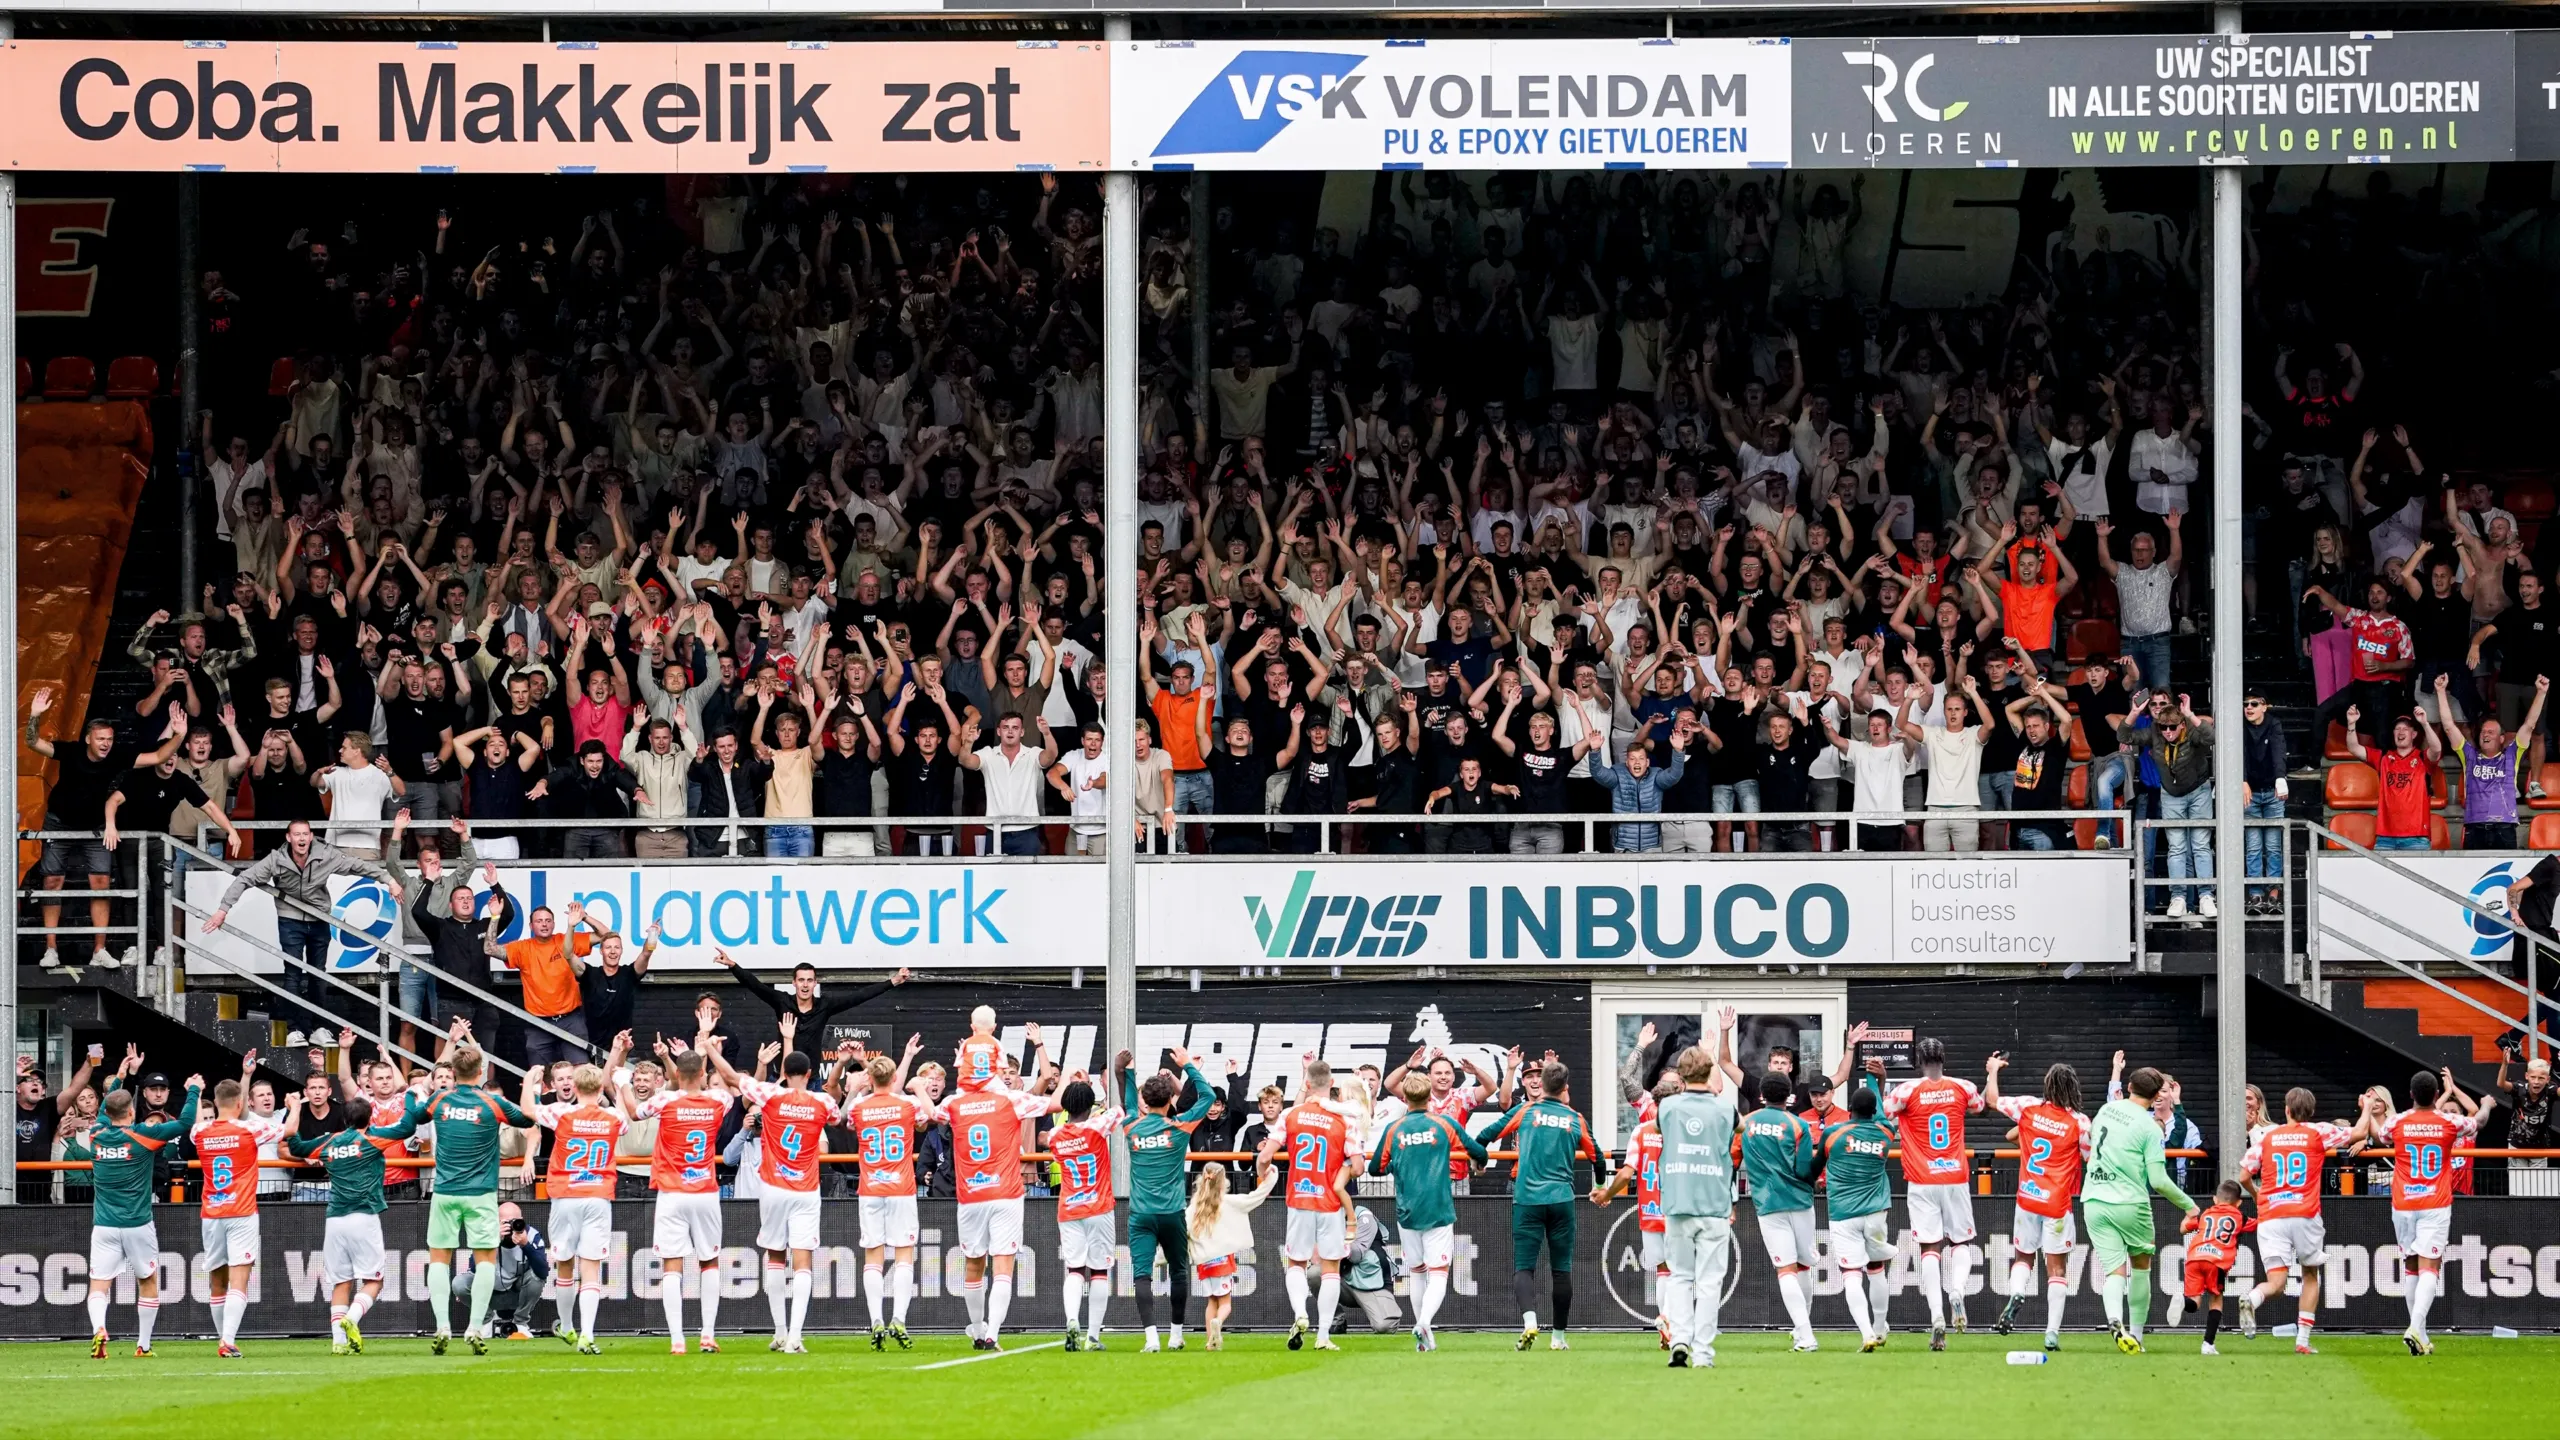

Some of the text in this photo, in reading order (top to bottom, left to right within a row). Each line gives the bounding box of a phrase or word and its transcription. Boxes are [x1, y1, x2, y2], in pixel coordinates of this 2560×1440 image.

[2155, 45, 2373, 79] UW SPECIALIST
[59, 57, 1021, 165] Coba. Makkelijk zat
[1228, 73, 1748, 120] VSK VOLENDAM
[2048, 80, 2481, 118] IN ALLE SOORTEN GIETVLOEREN
[1384, 127, 1748, 155] PU & EPOXY GIETVLOEREN
[1811, 131, 2002, 155] VLOEREN
[2072, 121, 2458, 154] www.rcvloeren.nl
[2357, 638, 2388, 656] HSB
[1911, 866, 2018, 889] industrial
[573, 870, 1009, 960] plaatwerk
[1469, 884, 1850, 959] INBUCO
[1911, 897, 2016, 922] business
[1911, 930, 2055, 959] consultancy
[972, 1051, 990, 1078] 9
[444, 1106, 478, 1122] HSB
[1536, 1112, 1571, 1129] HSB
[1750, 1123, 1783, 1136] HSB
[685, 1129, 706, 1163] 3
[780, 1124, 802, 1161] 4
[861, 1125, 905, 1164] 36
[968, 1124, 990, 1161] 9
[1134, 1134, 1169, 1149] HSB
[1400, 1131, 1435, 1146] HSB
[1849, 1139, 1884, 1155] HSB
[1928, 1113, 1950, 1150] 8
[97, 1147, 129, 1160] HSB
[328, 1145, 360, 1160] HSB
[565, 1137, 609, 1170] 20
[1296, 1132, 1328, 1173] 21
[1677, 1143, 1711, 1155] ESPN
[2026, 1137, 2052, 1175] 2
[2405, 1144, 2442, 1179] 10
[213, 1155, 232, 1191] 6
[1064, 1153, 1097, 1189] 17
[1665, 1163, 1723, 1177] CLUB MEDIA
[2272, 1151, 2307, 1188] 18
[2203, 1215, 2237, 1244] 18
